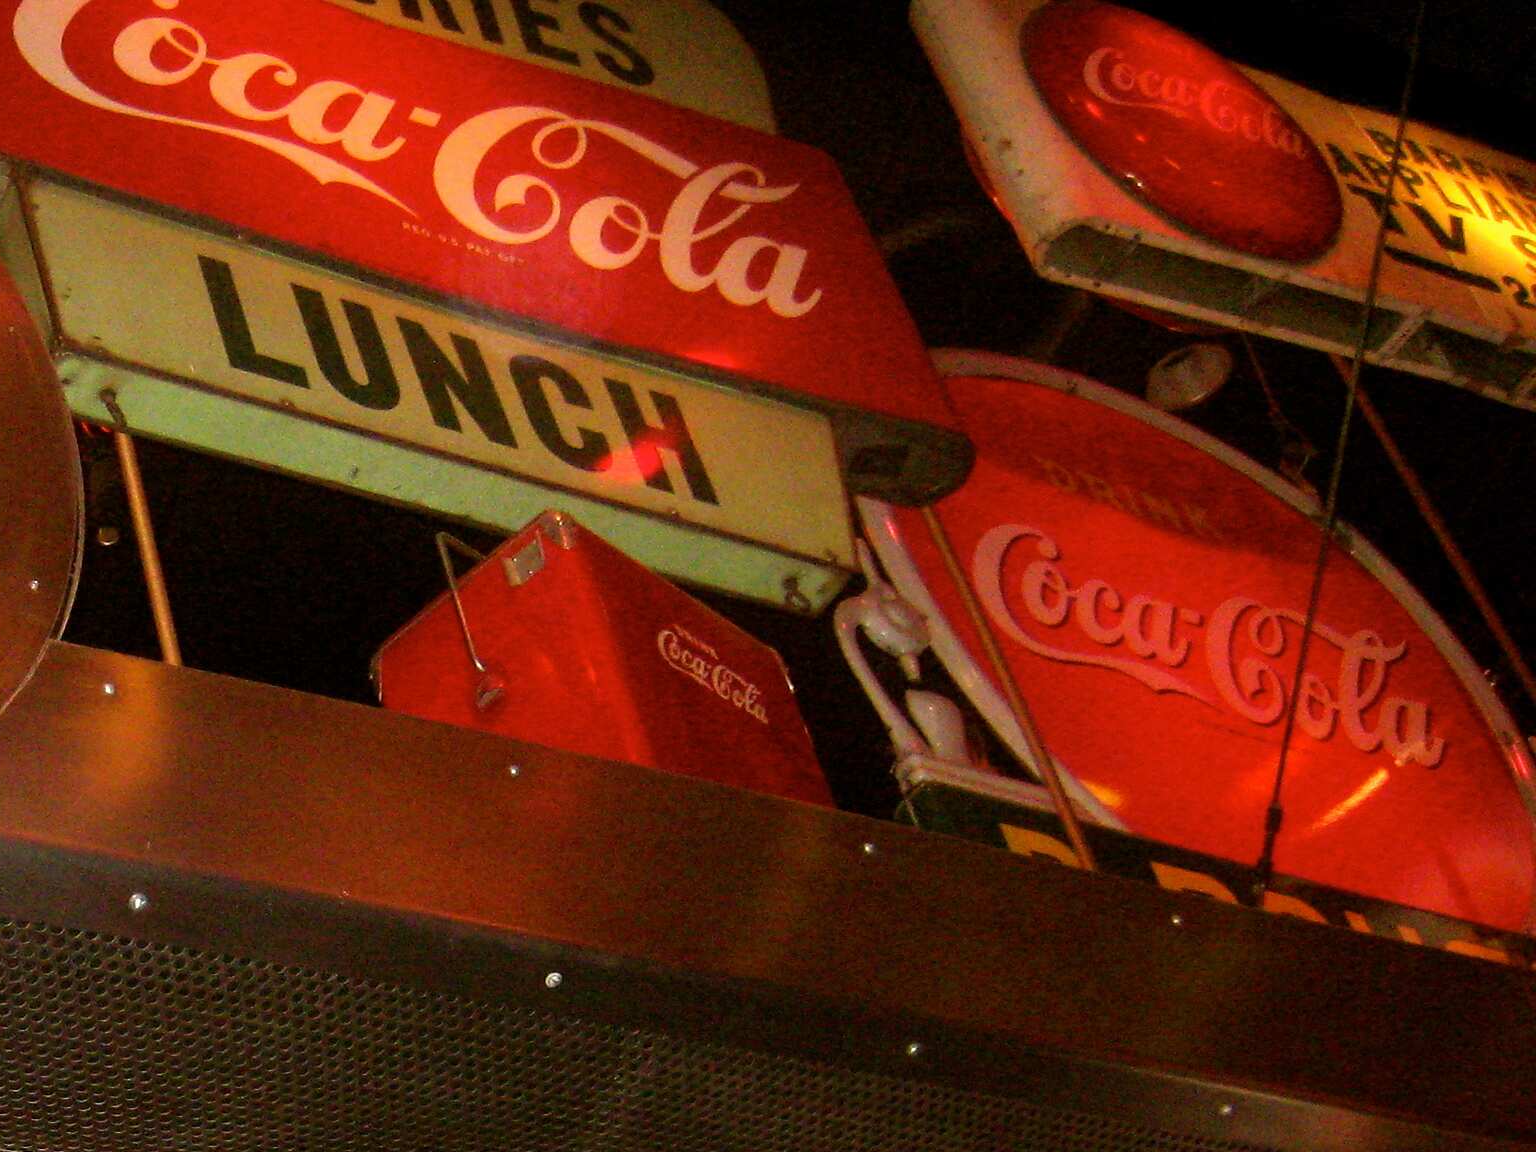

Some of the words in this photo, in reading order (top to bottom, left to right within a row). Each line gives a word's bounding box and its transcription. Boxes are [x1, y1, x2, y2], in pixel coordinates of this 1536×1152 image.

[13, 0, 822, 318] Coca-Cola
[1083, 47, 1307, 160] Coca-Cola
[1346, 184, 1466, 255] TV
[198, 255, 720, 505] LUNCH
[657, 630, 768, 724] Coca-Cola
[973, 524, 1445, 768] Coca-Cola
